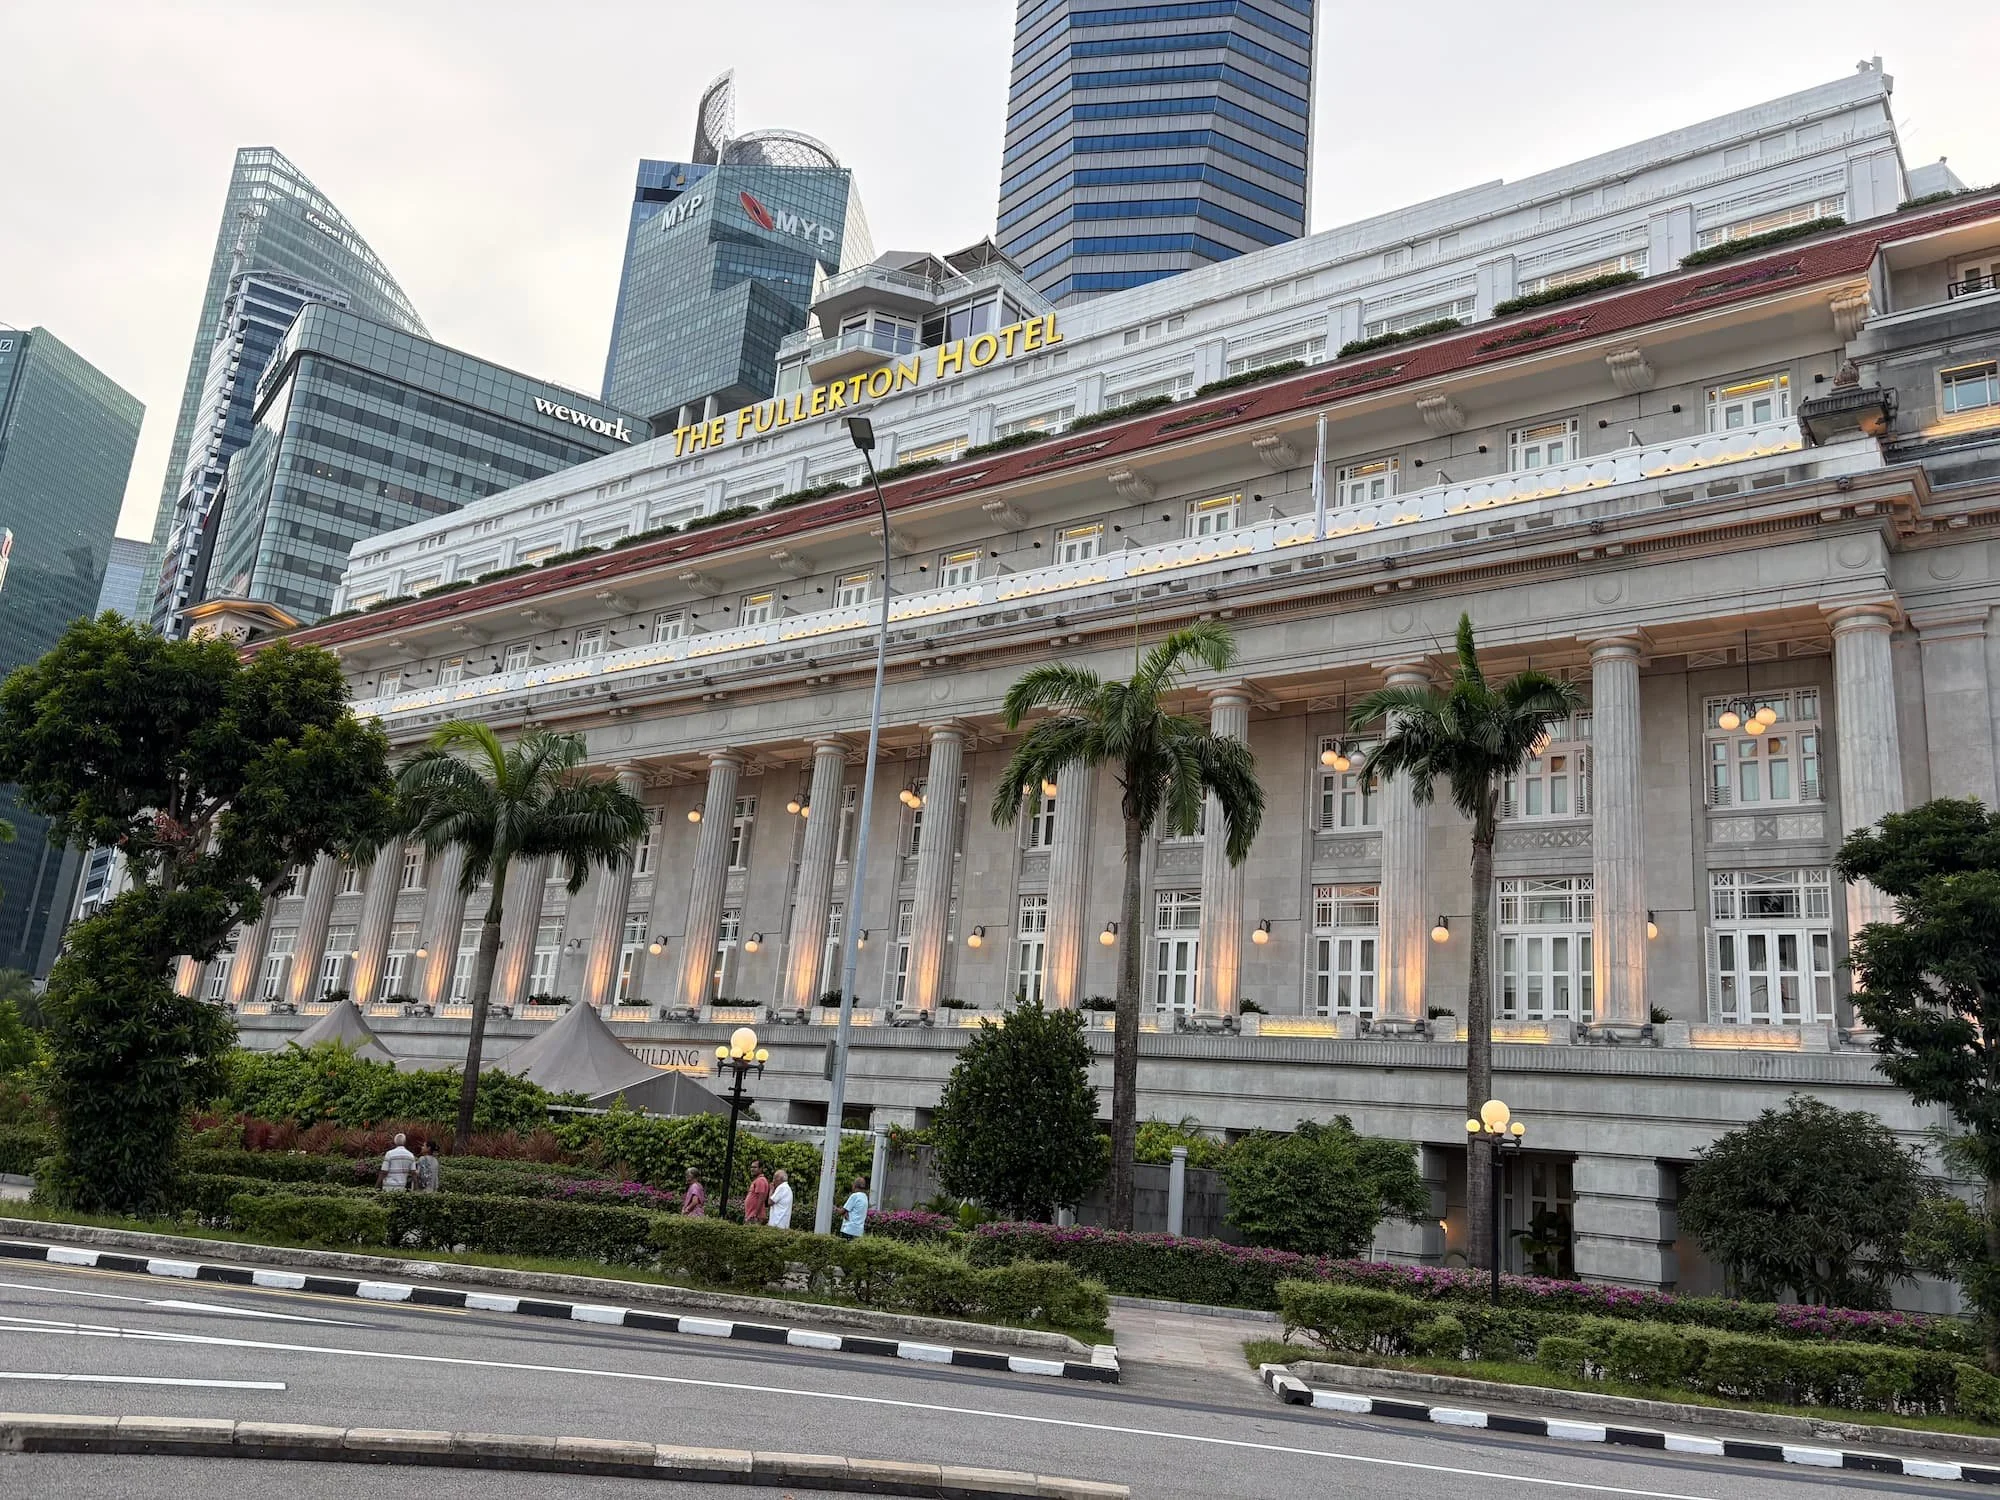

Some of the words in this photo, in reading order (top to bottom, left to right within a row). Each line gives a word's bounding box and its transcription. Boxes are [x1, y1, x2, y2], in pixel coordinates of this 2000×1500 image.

[306, 211, 342, 240] Keppel
[661, 194, 704, 232] MYP
[776, 209, 836, 246] MYP
[672, 417, 726, 457] THE
[735, 355, 921, 439] FULLERTON
[936, 312, 1064, 378] HOTEL
[533, 396, 633, 444] wework
